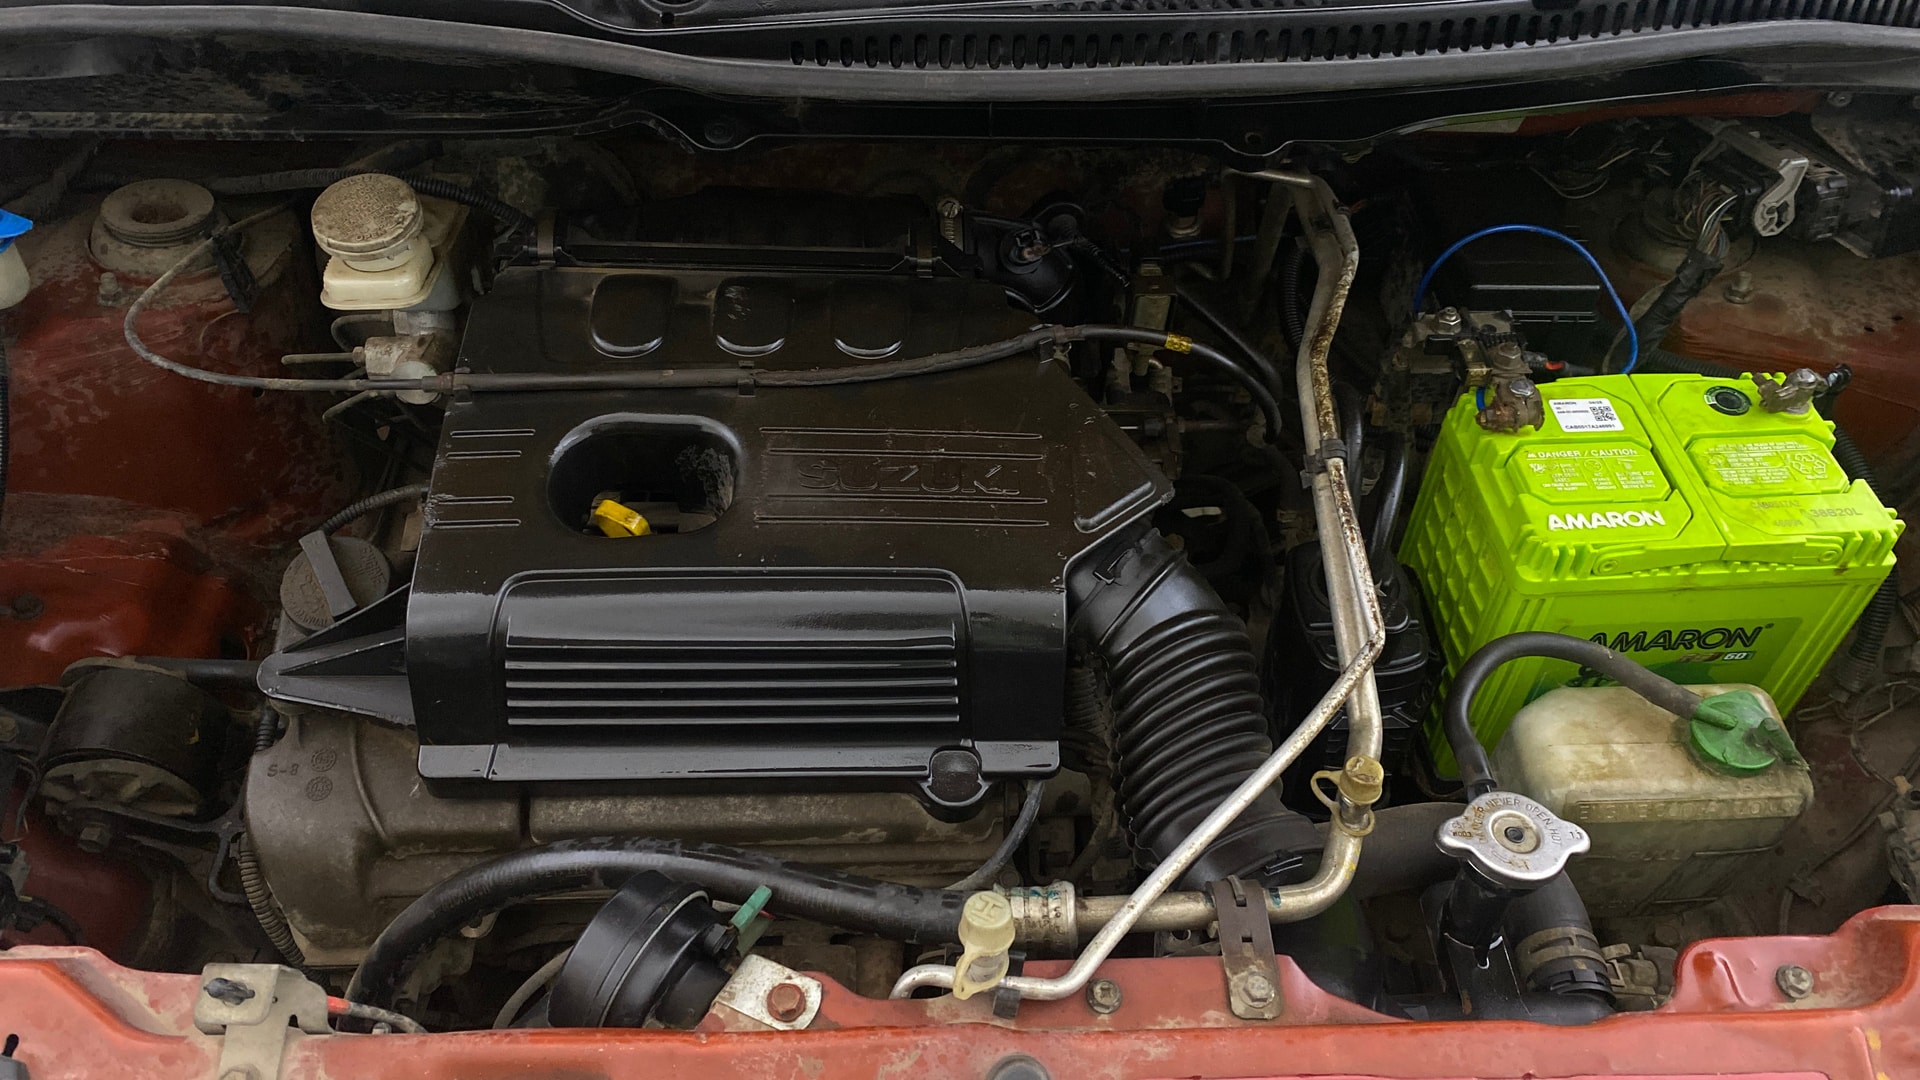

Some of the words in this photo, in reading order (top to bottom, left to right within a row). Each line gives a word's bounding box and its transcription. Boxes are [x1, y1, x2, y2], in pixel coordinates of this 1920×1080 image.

[1537, 450, 1581, 458] DANGER
[1591, 448, 1638, 457] CAUTION
[1548, 510, 1666, 531] AMARON
[1588, 626, 1763, 653] AMARON
[1485, 797, 1521, 812] NEVER
[1525, 803, 1552, 827] OPEN
